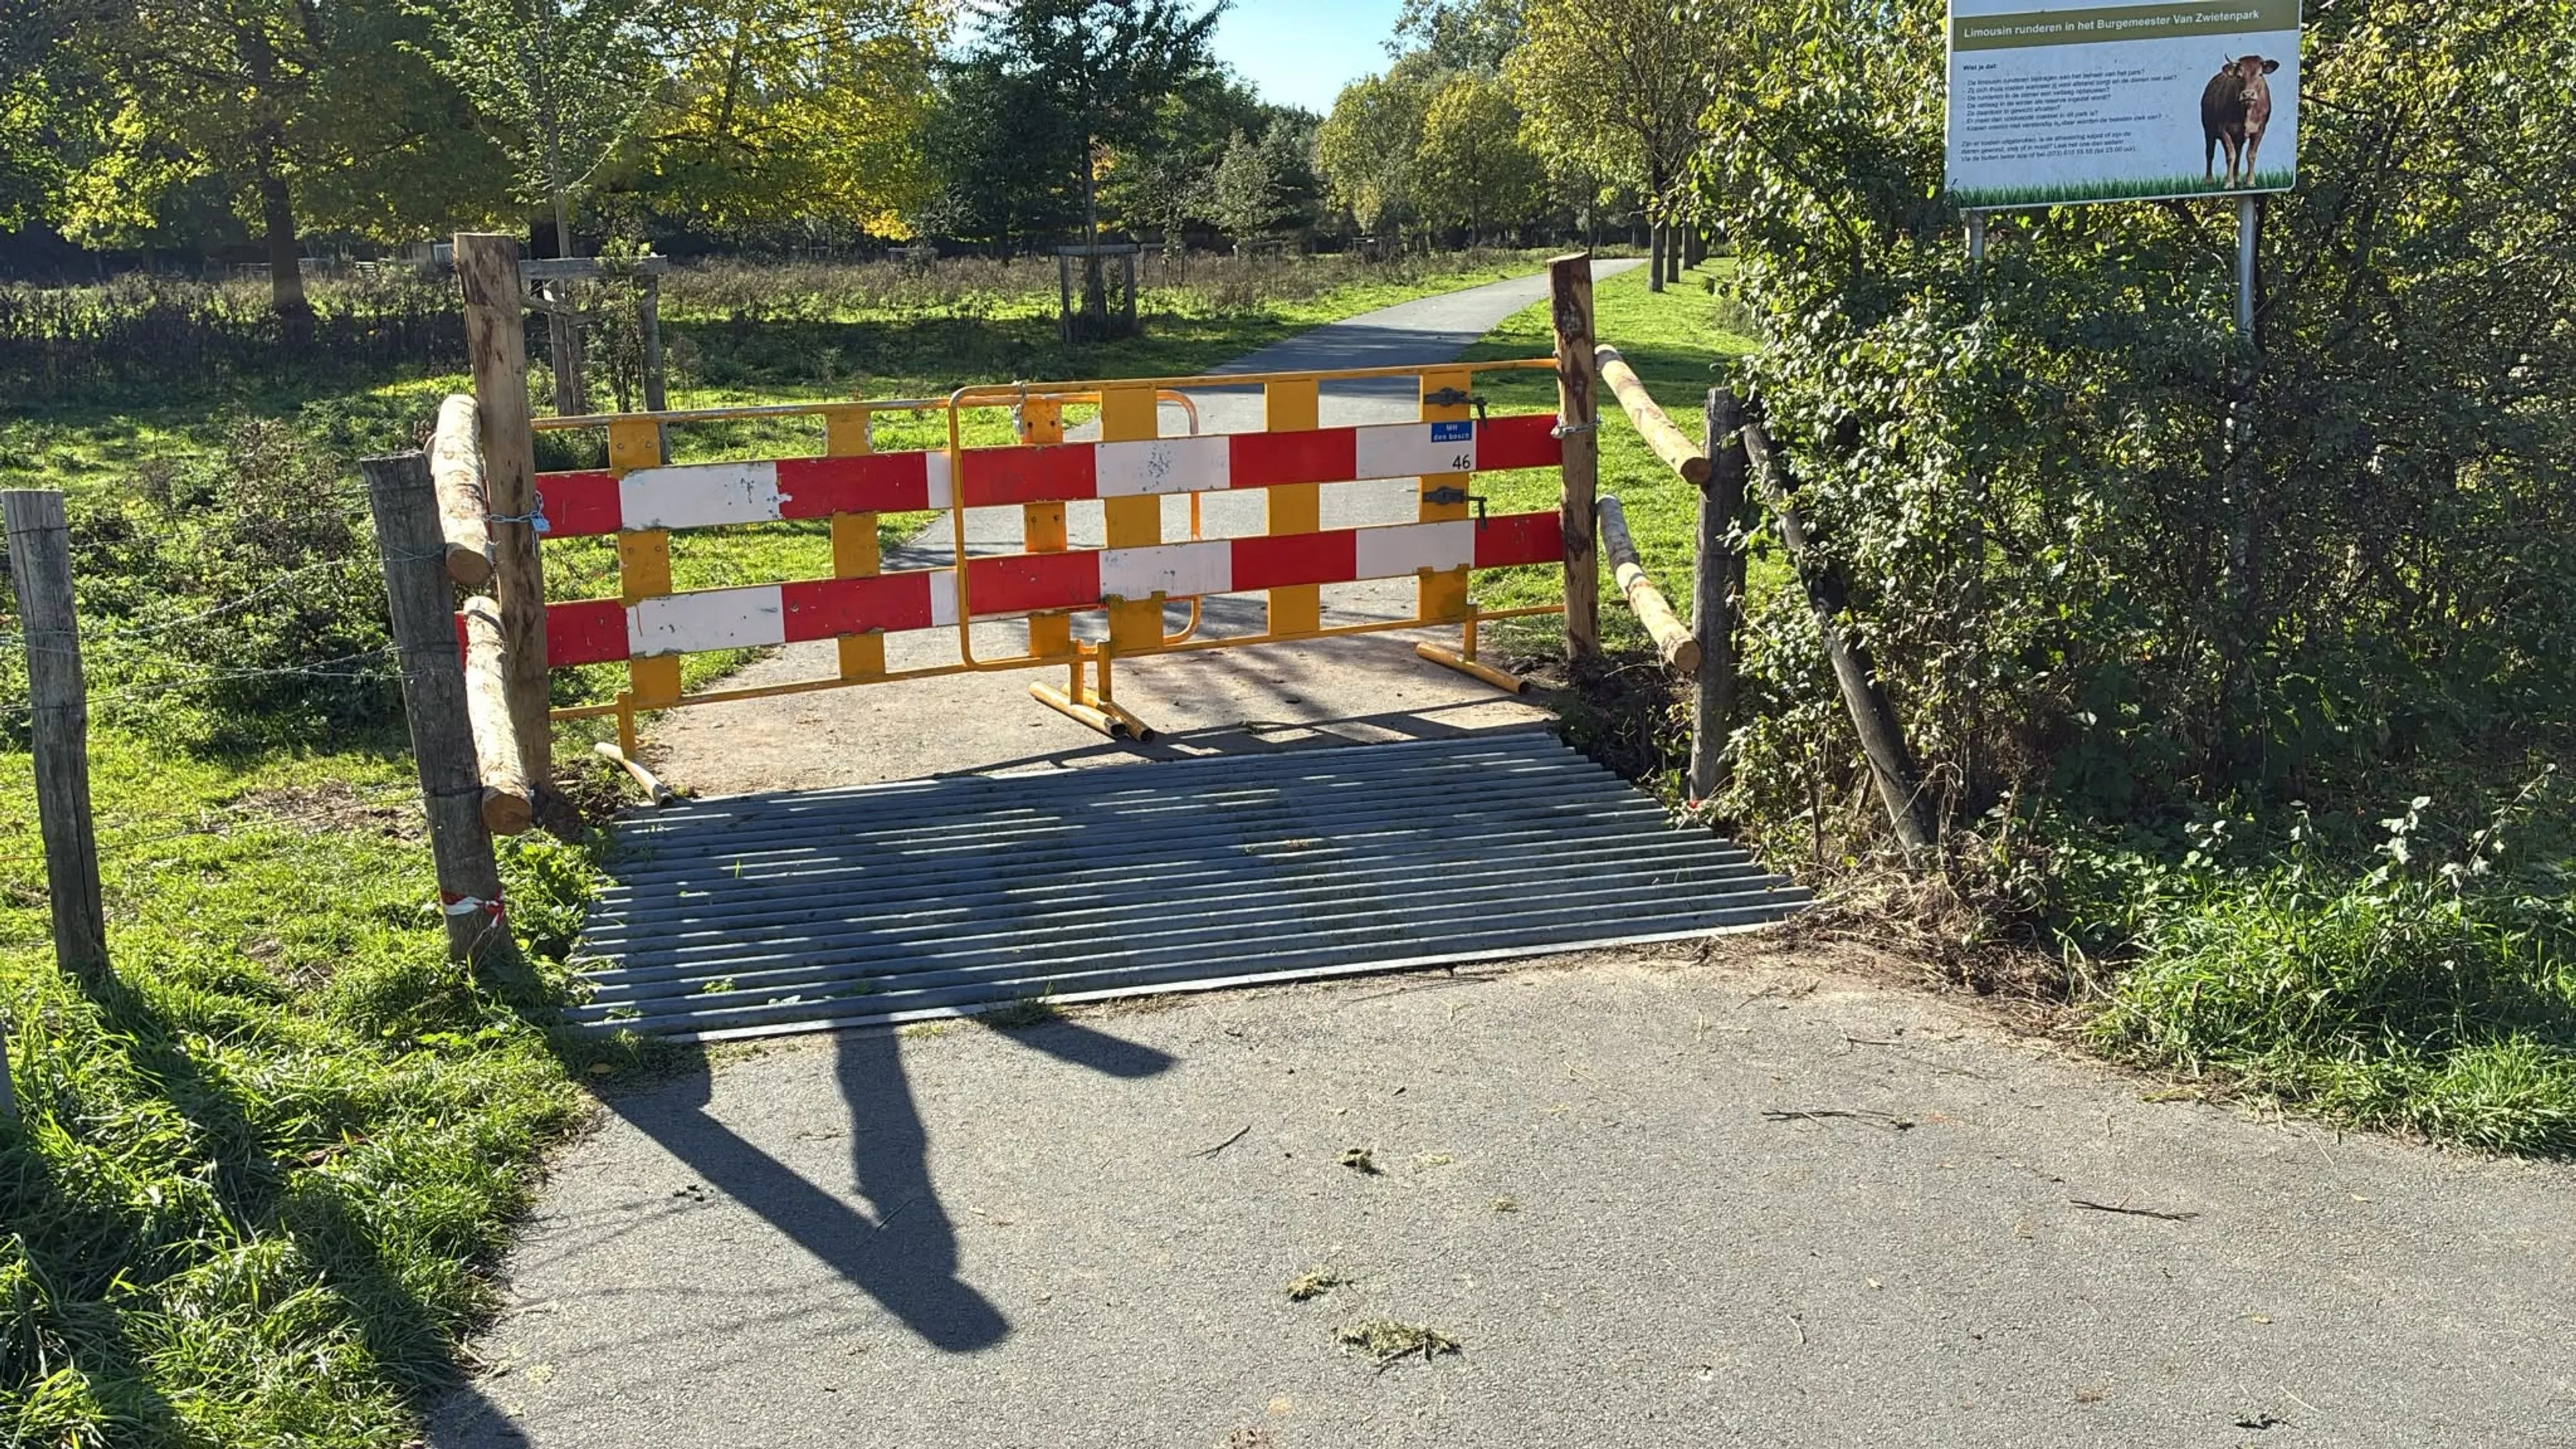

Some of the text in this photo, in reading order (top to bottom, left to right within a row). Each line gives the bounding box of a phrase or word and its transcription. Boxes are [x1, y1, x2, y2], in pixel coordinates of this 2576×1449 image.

[1964, 10, 2259, 37] Limousin runderen in het Burgemeester Van Zwietenpark
[1452, 453, 1470, 470] 46
